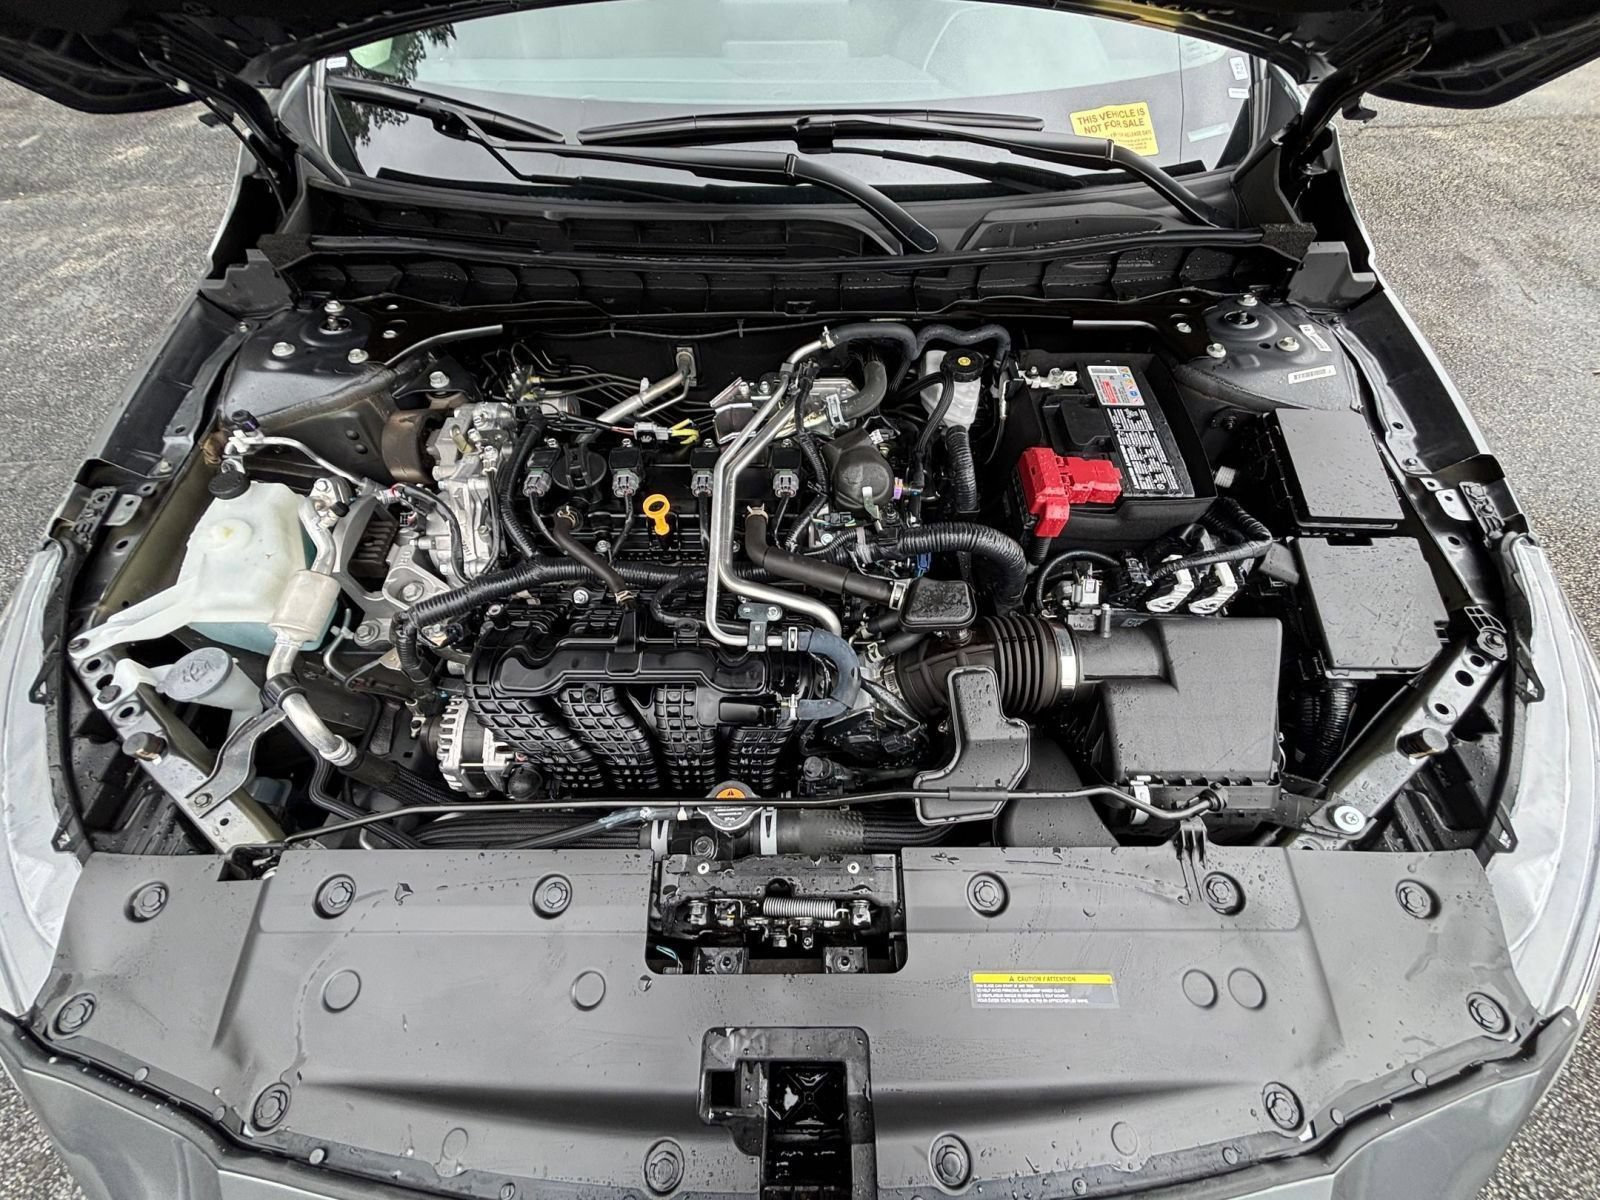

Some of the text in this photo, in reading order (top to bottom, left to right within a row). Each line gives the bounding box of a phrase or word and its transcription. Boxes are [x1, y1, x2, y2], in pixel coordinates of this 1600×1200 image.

[1077, 107, 1145, 125] THIS VEHICLE IS
[1084, 118, 1144, 134] NOT FOR SALE
